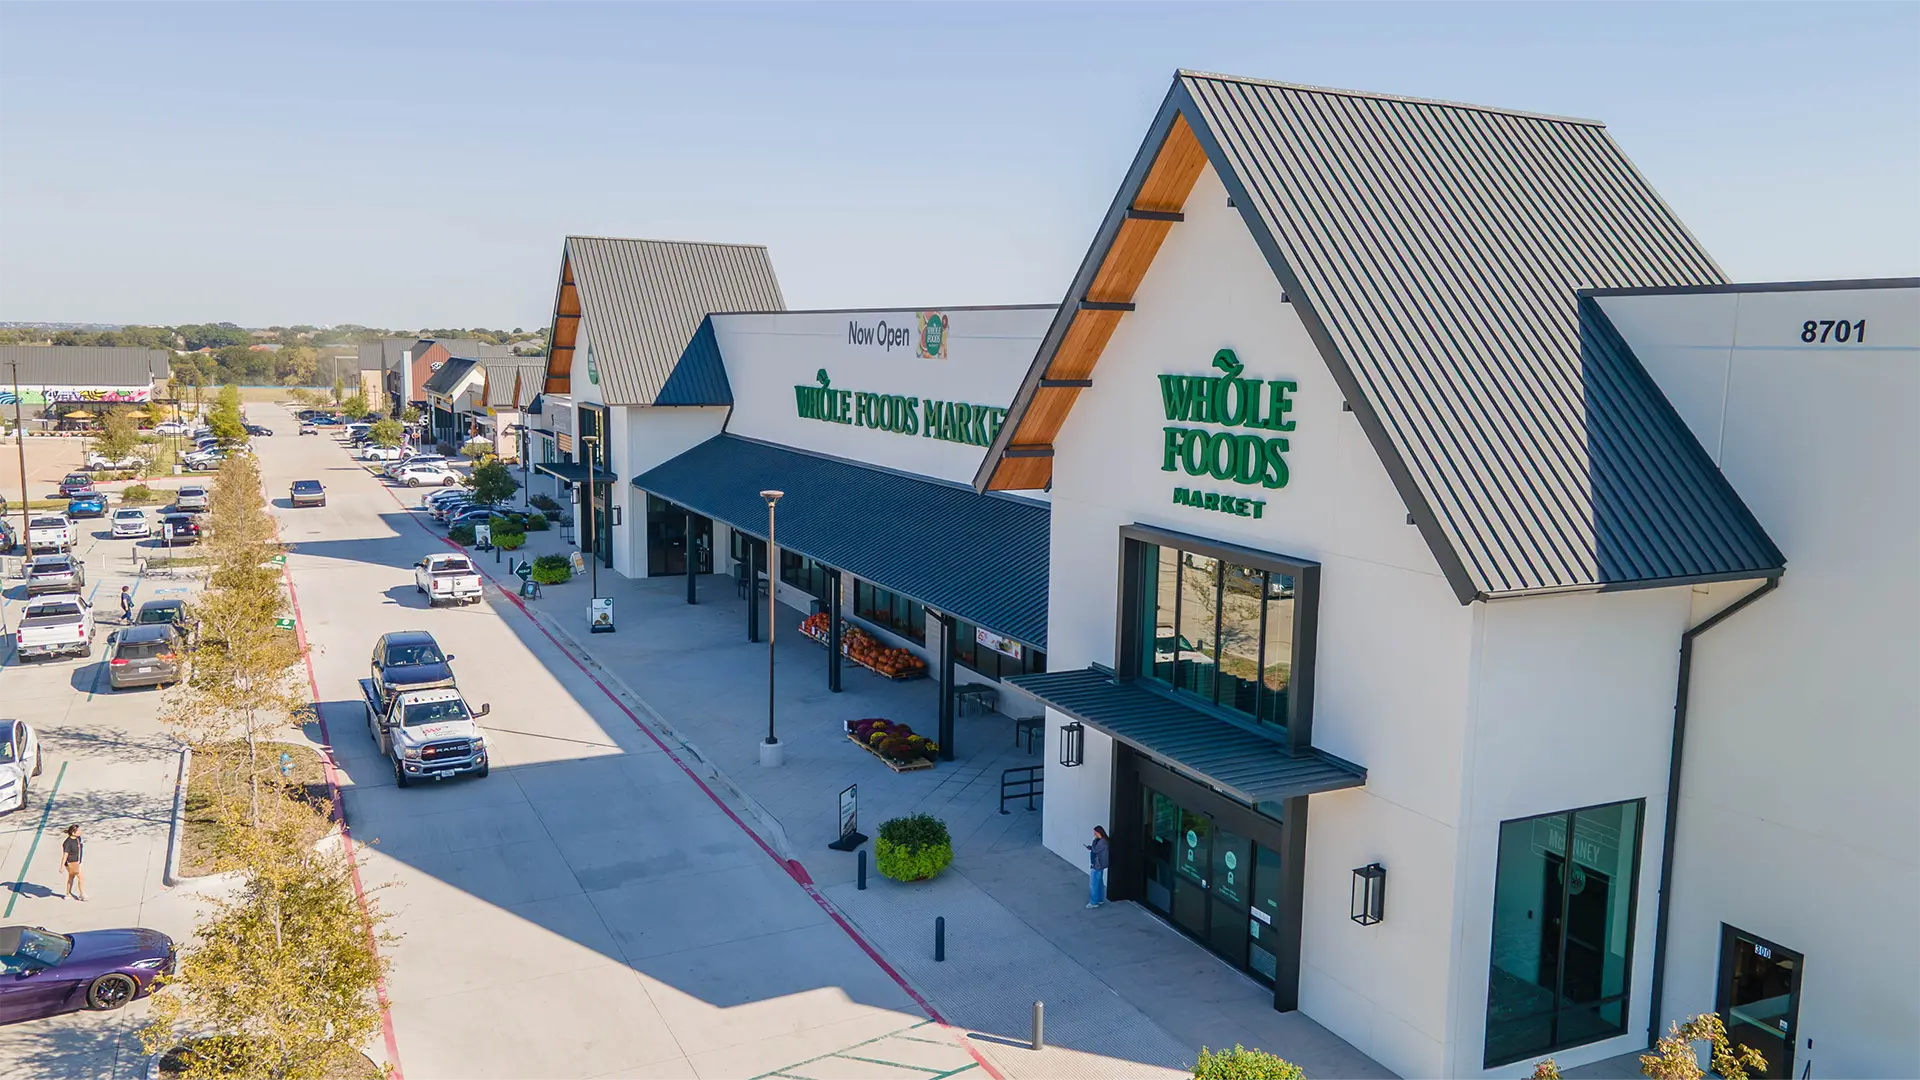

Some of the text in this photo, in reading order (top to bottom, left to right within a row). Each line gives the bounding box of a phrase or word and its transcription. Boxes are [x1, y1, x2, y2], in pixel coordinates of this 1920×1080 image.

[849, 320, 910, 351] Now Open
[927, 325, 942, 335] WHOLE
[927, 334, 942, 343] FOODS
[1801, 319, 1866, 343] 8701
[794, 385, 1008, 447] WHOLE FOODS MARKE
[1157, 374, 1298, 431] WHOLE
[1161, 427, 1290, 489] FOODS
[1172, 487, 1267, 519] MARKET
[1549, 829, 1600, 864] McNNEY
[1755, 944, 1771, 959] 300
